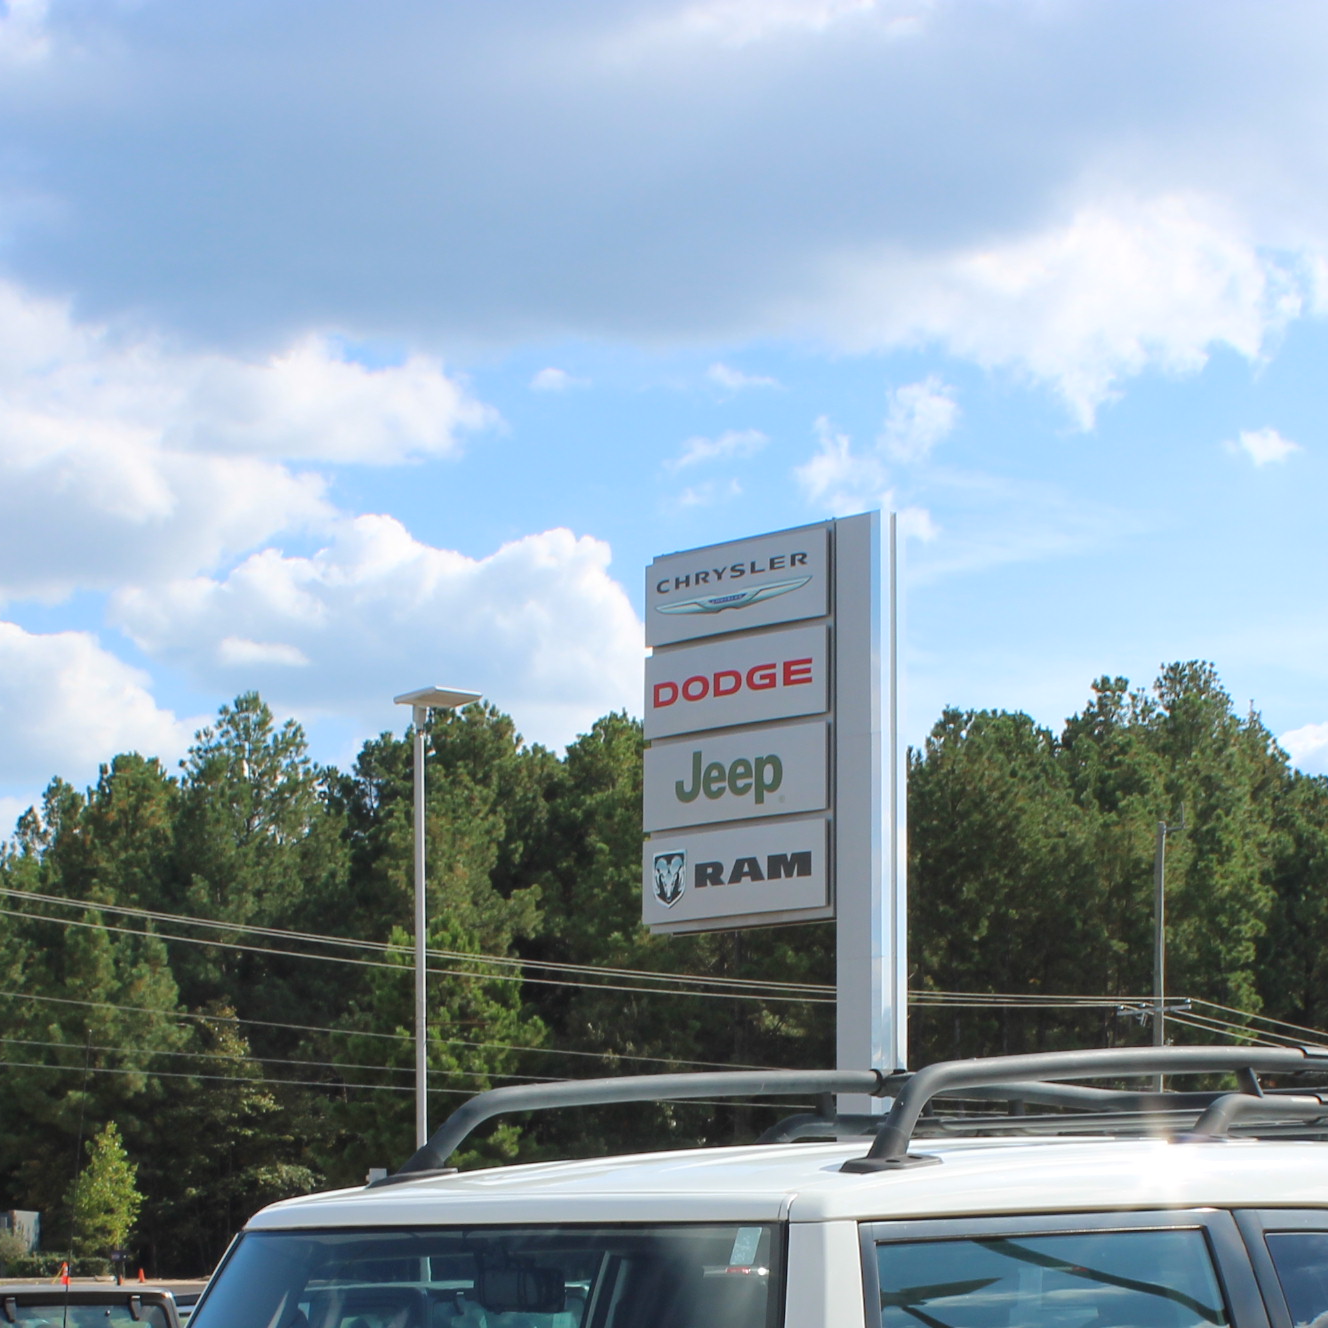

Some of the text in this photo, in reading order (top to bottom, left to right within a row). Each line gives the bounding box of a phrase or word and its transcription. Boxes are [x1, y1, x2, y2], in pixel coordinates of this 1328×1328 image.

[656, 551, 808, 594] CHRYSLER
[653, 657, 813, 709] DODGE
[675, 750, 783, 805] Jeep
[694, 850, 812, 889] RAM
